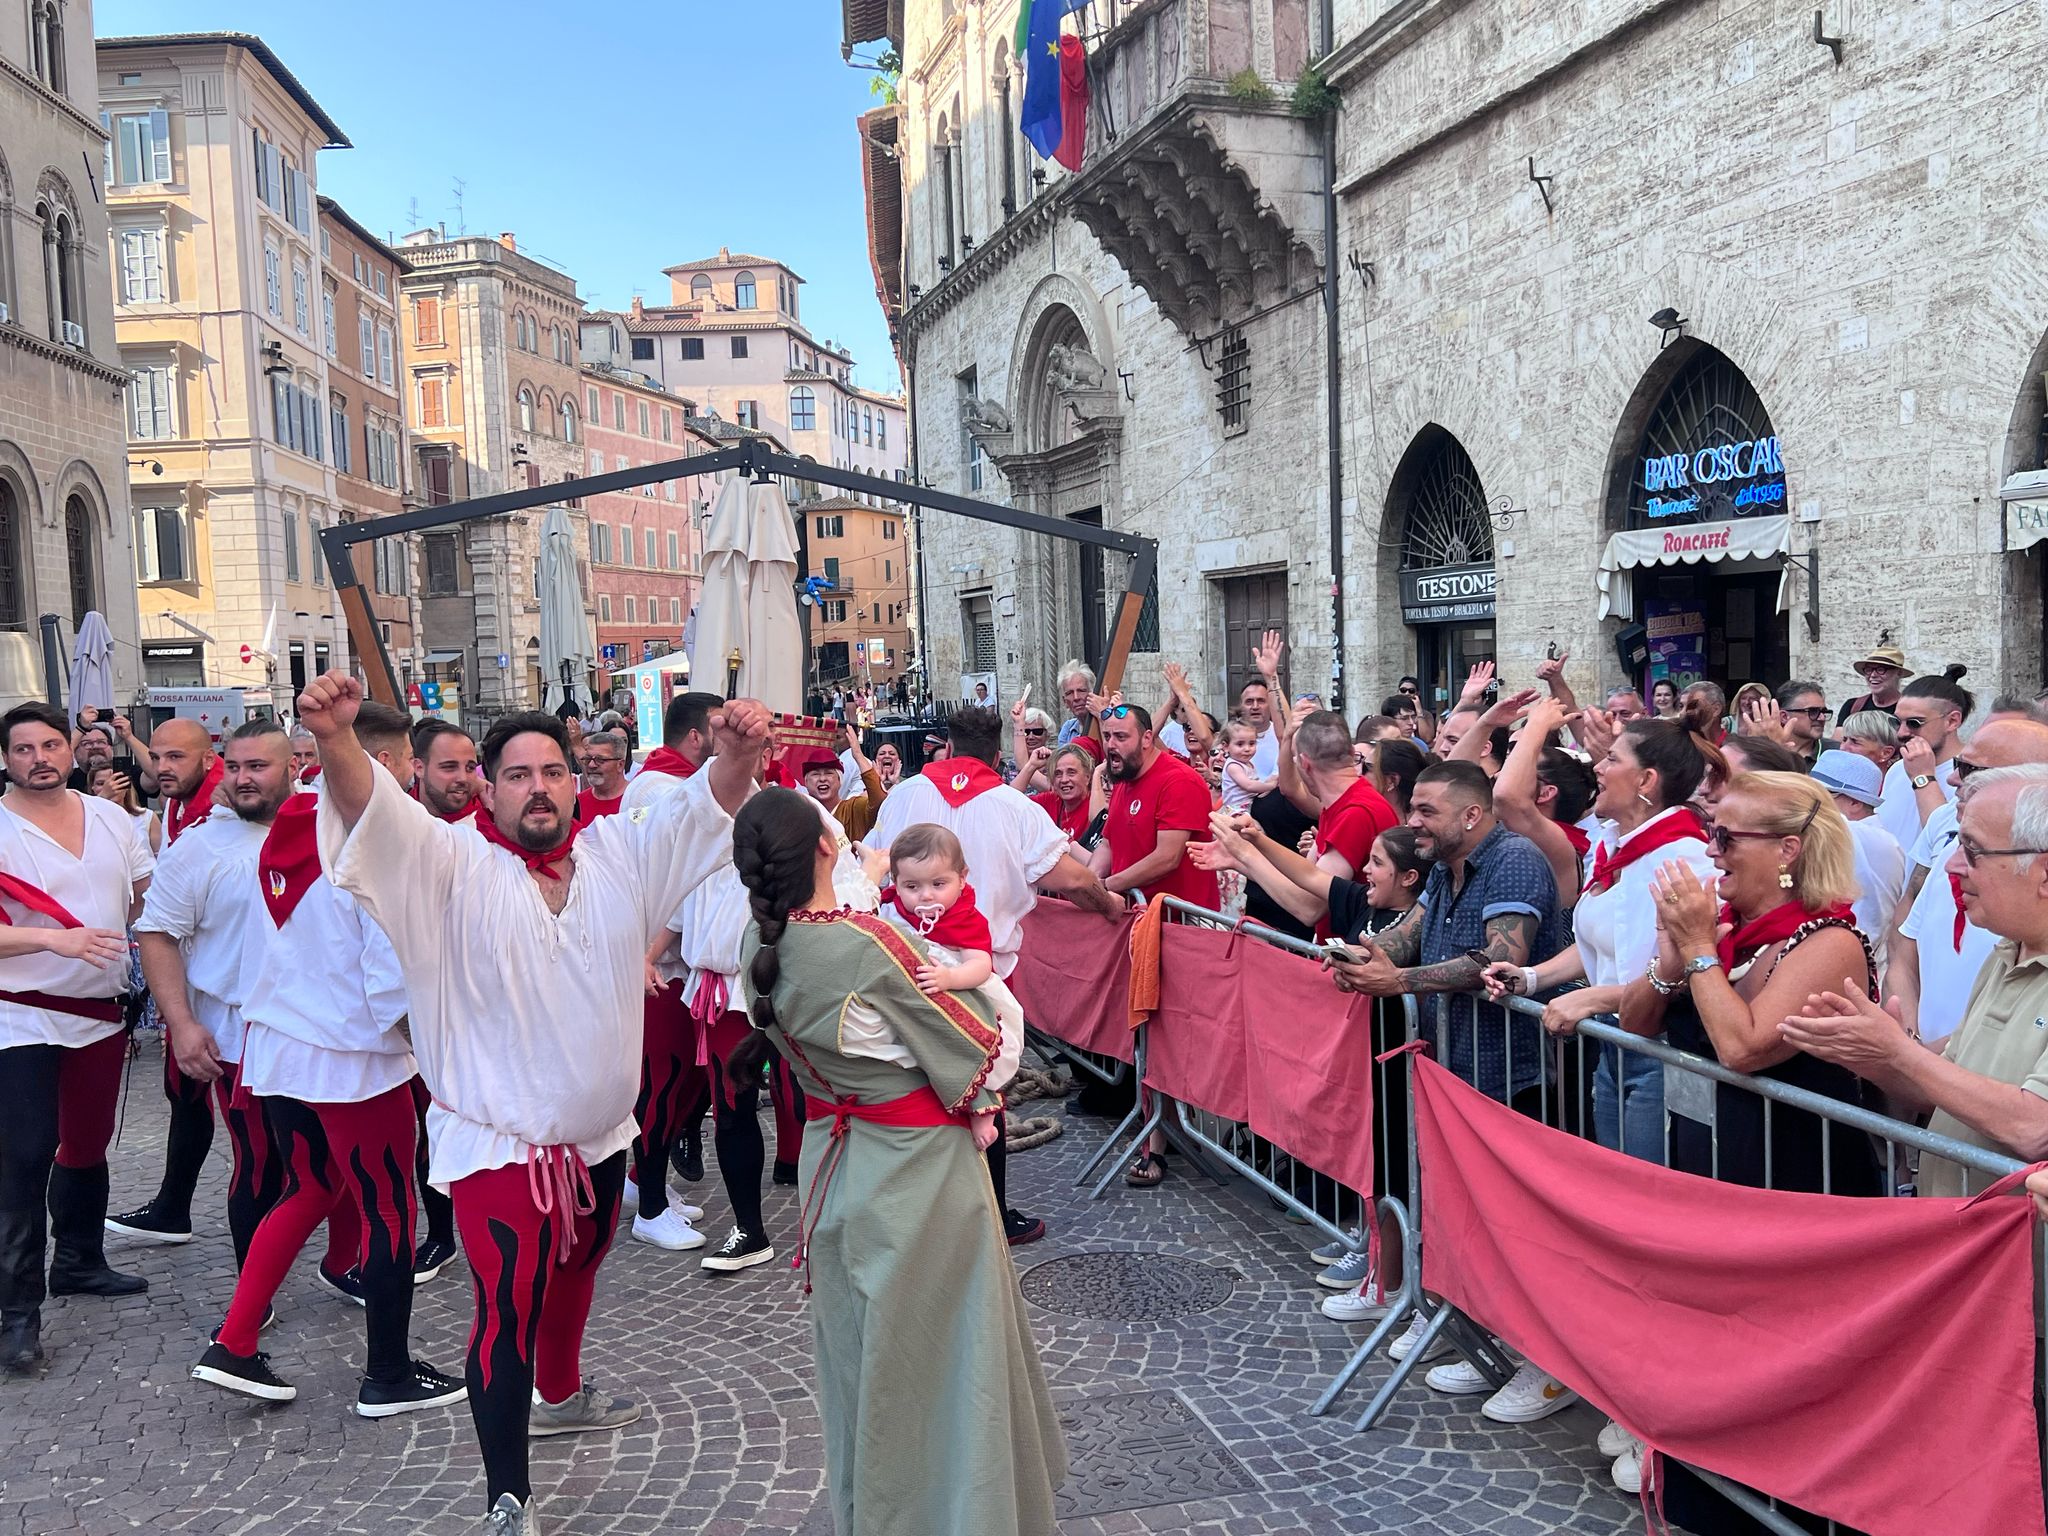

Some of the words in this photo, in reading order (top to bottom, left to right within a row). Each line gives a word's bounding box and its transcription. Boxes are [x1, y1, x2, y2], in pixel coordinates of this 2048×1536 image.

[1645, 453, 1690, 491] BAR
[1693, 436, 1785, 483] OSCAR
[1735, 486, 1755, 507] dal
[2017, 505, 2048, 529] FA
[1418, 573, 1496, 598] TESTONE
[1405, 607, 1422, 619] TORTA
[1423, 607, 1430, 618] AL
[1431, 605, 1448, 617] TESTO
[1454, 602, 1483, 616] BRACERIA
[148, 648, 193, 656] SKECHERS
[154, 695, 183, 703] ROSSA
[185, 695, 224, 703] ITALIANA
[408, 683, 457, 710] ABC
